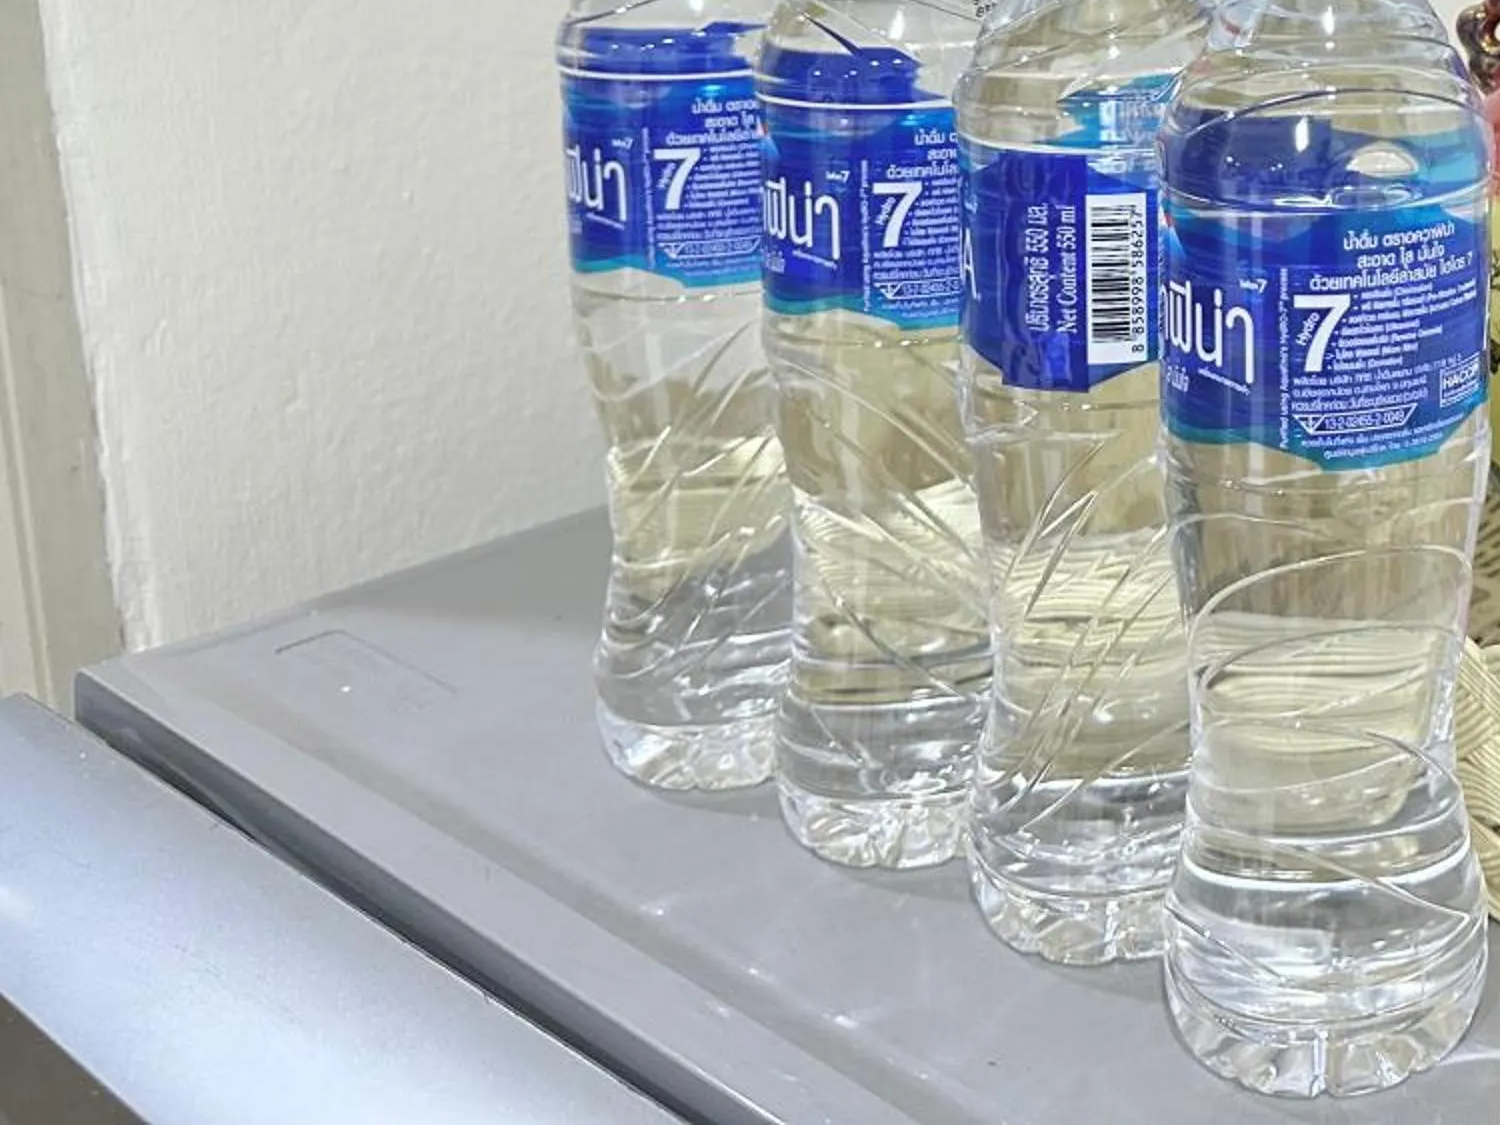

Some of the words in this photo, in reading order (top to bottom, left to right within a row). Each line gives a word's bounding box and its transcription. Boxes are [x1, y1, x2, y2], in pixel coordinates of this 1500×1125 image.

[654, 147, 701, 211] 7
[872, 182, 923, 248] 7
[1025, 228, 1049, 253] 550
[1056, 227, 1077, 249] 550
[1343, 228, 1379, 251] น้ำดื่ม
[1357, 252, 1396, 269] สะอาด
[1056, 253, 1077, 306] Content
[1056, 308, 1077, 334] Net
[1293, 293, 1351, 373] 7
[1295, 312, 1320, 346] Hydro
